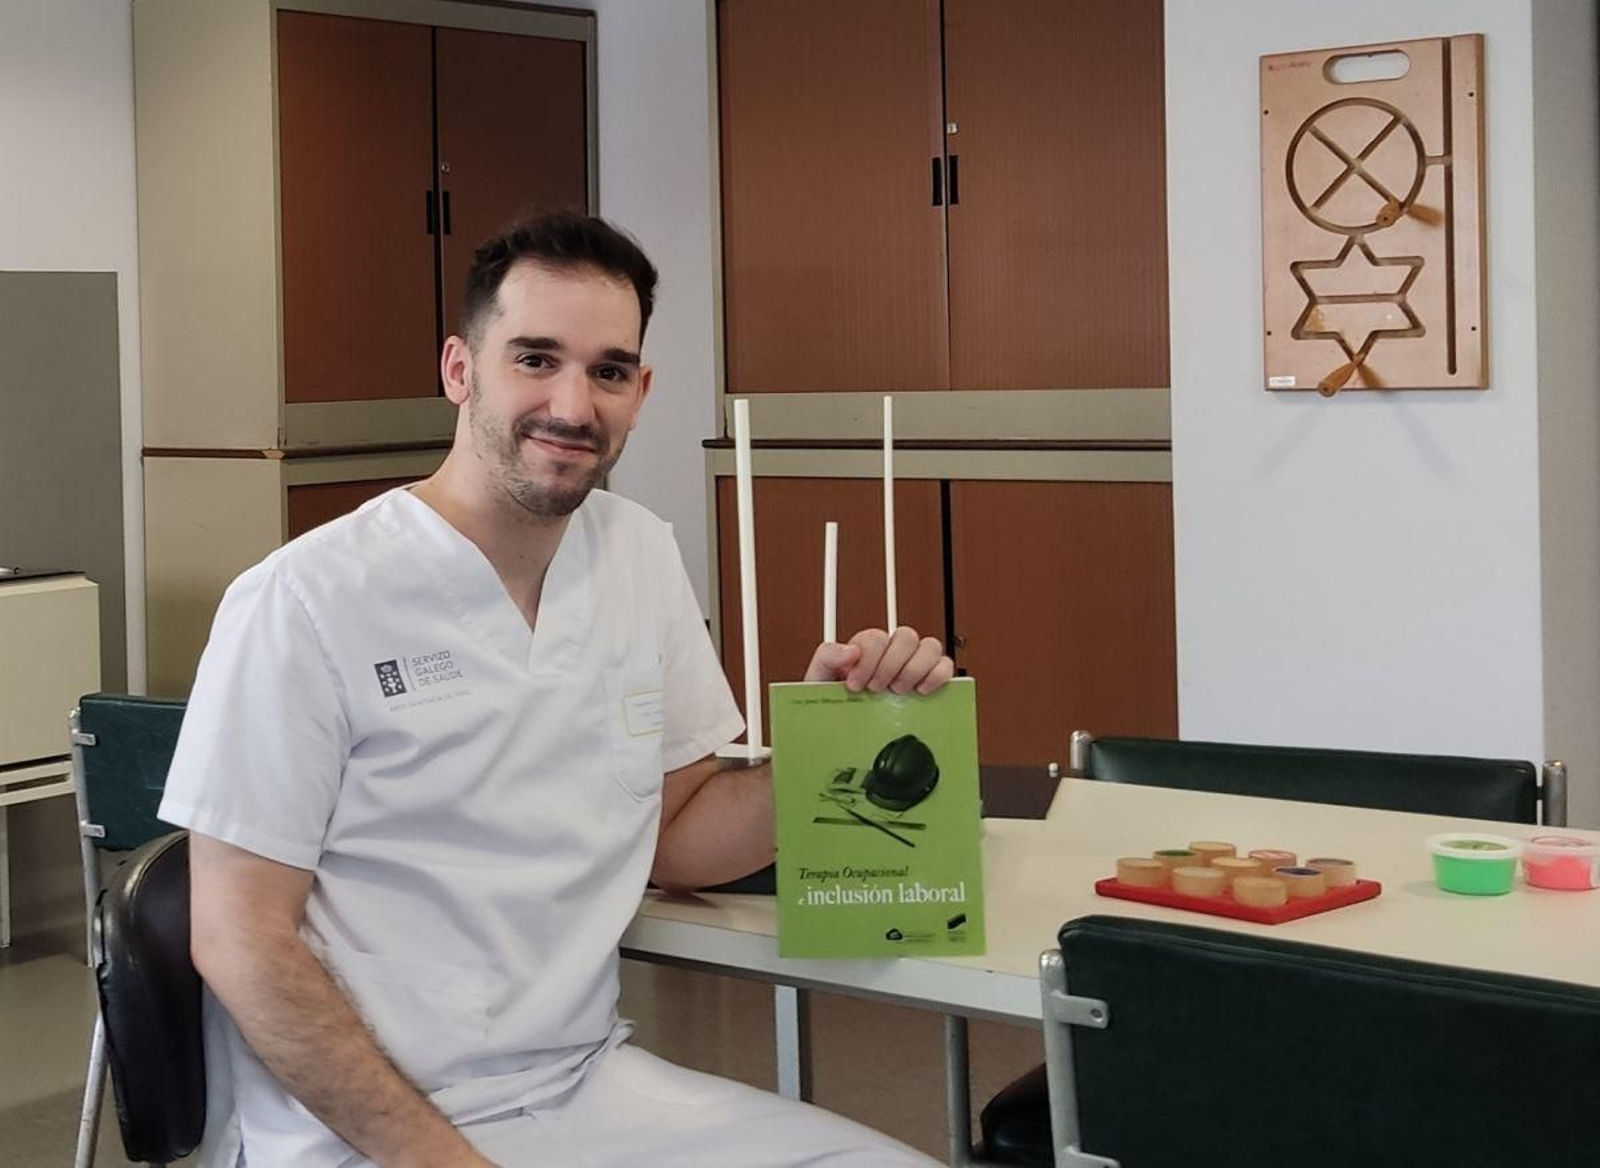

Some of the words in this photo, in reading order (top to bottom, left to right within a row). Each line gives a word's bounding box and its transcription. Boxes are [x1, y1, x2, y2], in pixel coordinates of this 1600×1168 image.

[412, 650, 450, 666] SERVIZO
[415, 660, 454, 676] GALEGO
[418, 677, 432, 687] DE
[799, 867, 840, 883] Terapia
[843, 865, 909, 881] Ocupacional
[807, 884, 893, 905] inclusión
[899, 881, 965, 903] laboral
